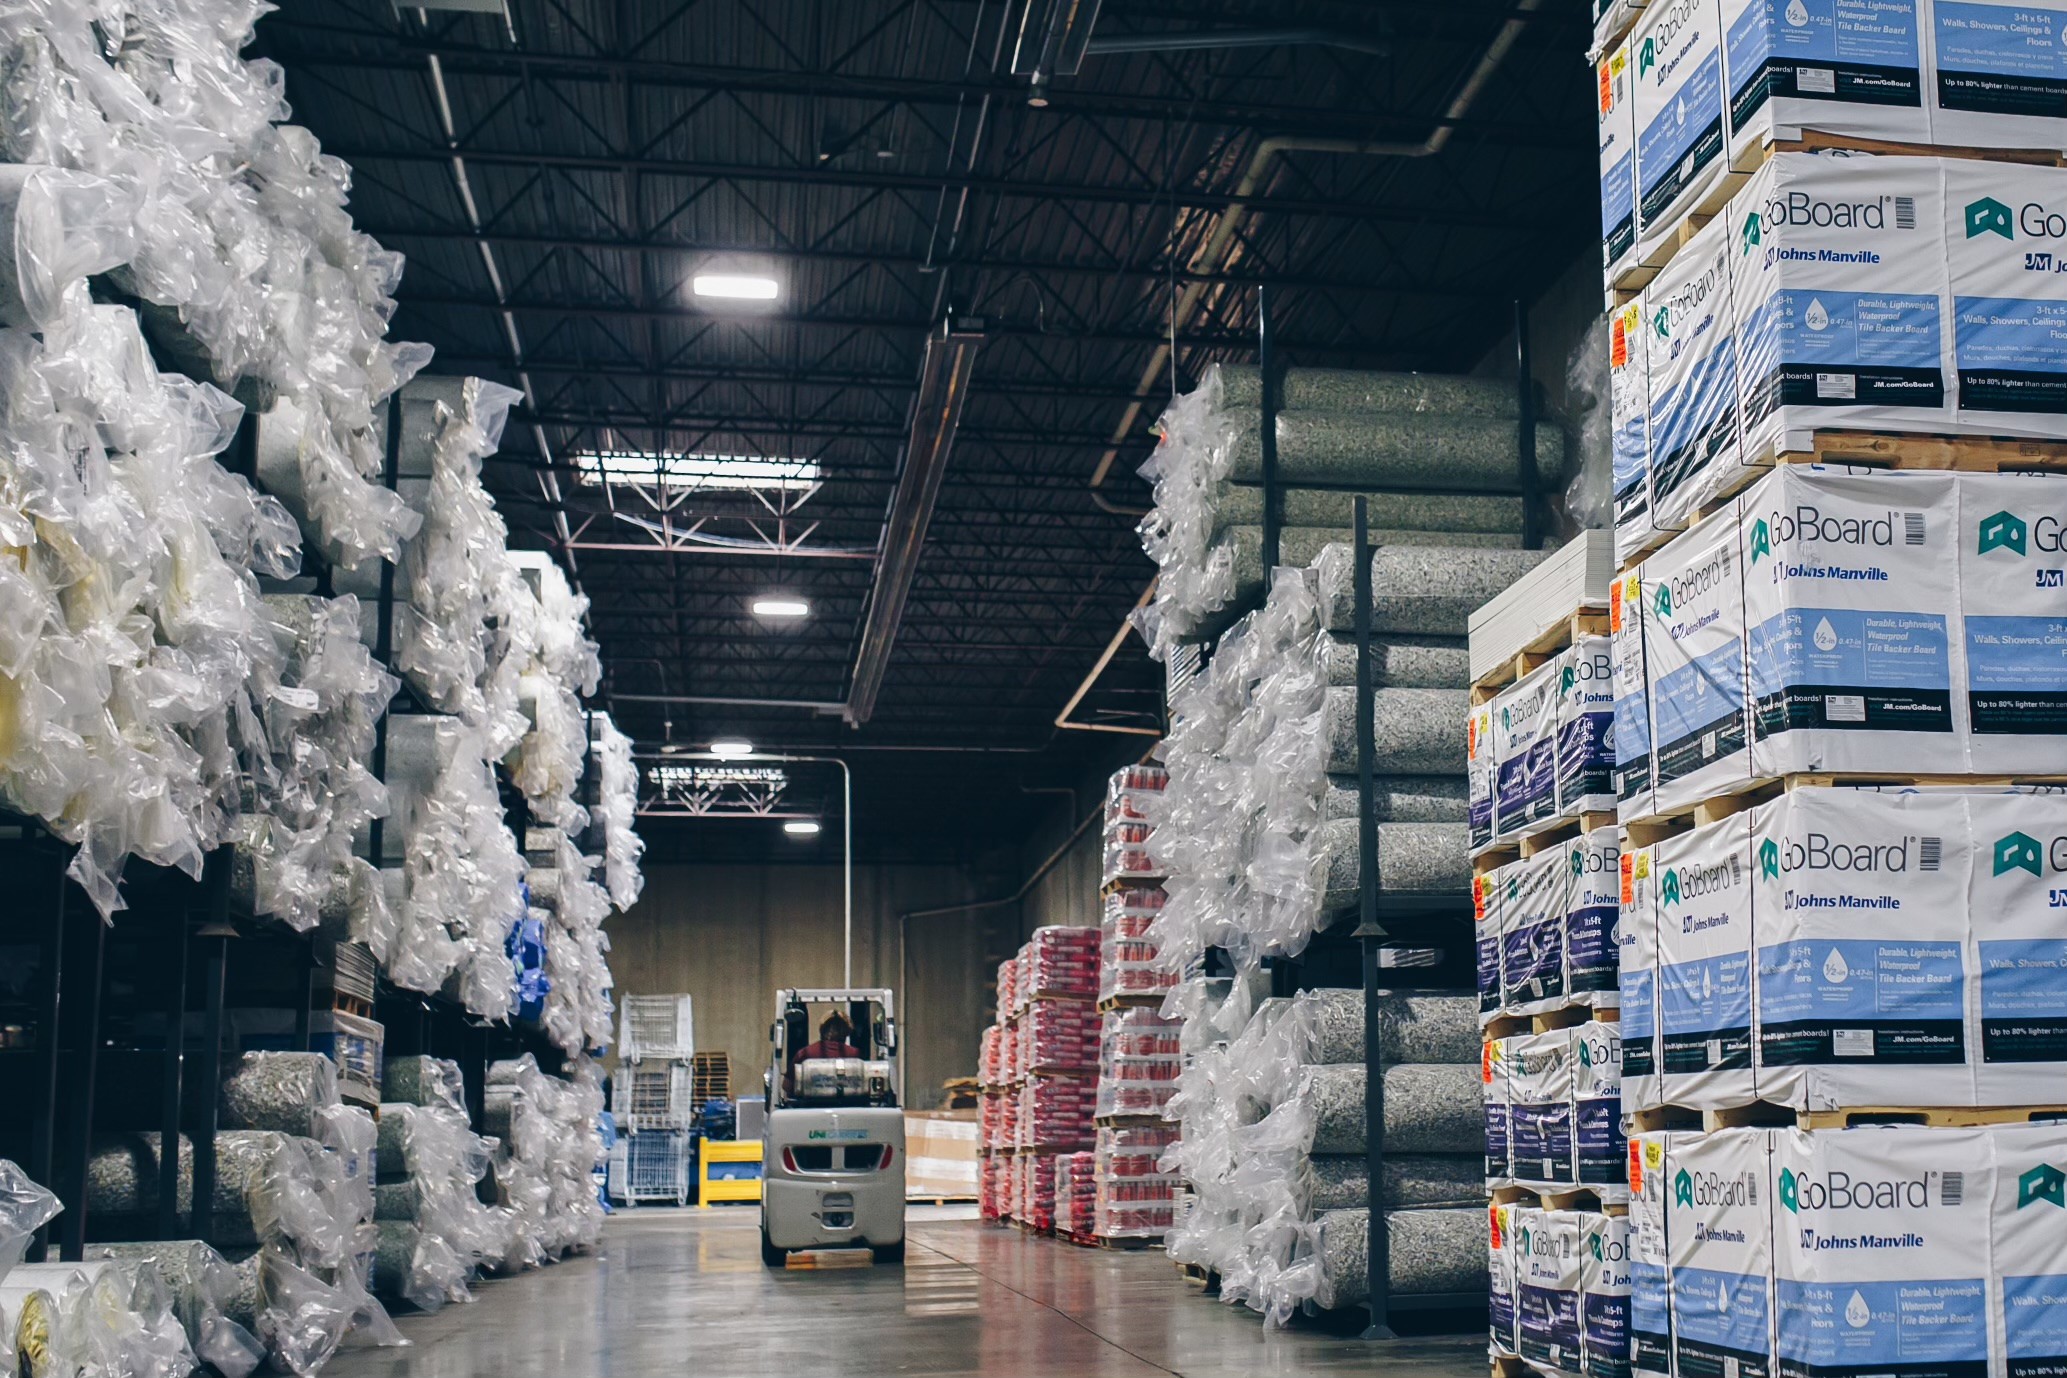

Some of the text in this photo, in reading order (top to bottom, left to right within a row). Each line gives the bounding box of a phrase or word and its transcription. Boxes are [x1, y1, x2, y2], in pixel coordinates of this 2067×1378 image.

[1837, 10, 1878, 22] Waterproof
[2014, 13, 2029, 23] 3-ft
[2036, 15, 2051, 25] 5-ft
[1837, 21, 1906, 36] Tile Backer Board
[1942, 18, 2052, 38] Walls, Showers, Ceilings &
[2026, 37, 2053, 47] Floors
[1945, 78, 1956, 87] Up
[1965, 80, 1980, 89] 80%
[1980, 82, 2003, 92] lighter
[2004, 83, 2019, 92] than
[2020, 85, 2044, 94] cement
[1775, 247, 1881, 265] Johns Manville
[1858, 298, 1936, 313] Durable, Lightweight,
[2036, 306, 2050, 315] 3-ft
[1858, 312, 1901, 323] Waterproof
[1962, 314, 2066, 328] Walls, Showers, Ceilings
[1859, 324, 1929, 335] Tile Backer Board
[1786, 372, 1814, 381] boards!
[1872, 381, 1935, 390] JM.com/GoBoard
[1967, 377, 1978, 386] Up
[1978, 378, 1986, 386] to
[1986, 378, 2001, 387] 80%
[2002, 379, 2024, 389] lighter
[2024, 380, 2041, 388] than
[1769, 505, 1892, 548] GoBoard
[1784, 563, 1889, 582] Johns Manville
[1866, 618, 1898, 628] Durable,
[2048, 624, 2062, 633] 3-ft
[1867, 630, 1909, 642] Waterproof
[1974, 634, 2043, 646] Walls, Showers,
[1866, 642, 1936, 655] Tile Backer Board
[1794, 694, 1822, 702] boards!
[1882, 704, 1942, 712] JM.com/GoBoard
[1977, 700, 1988, 708] Up
[1998, 700, 2014, 708] 80%
[2015, 700, 2038, 709] lighter
[1780, 832, 1907, 873] GoBoard
[1680, 856, 1730, 901] GoBoard
[1794, 893, 1901, 910] Johns Manville
[1878, 946, 1958, 960] Durable, Lightweight,
[1880, 960, 1921, 972] Waterproof
[1989, 958, 2059, 969] Walls, Showers,
[1879, 973, 1952, 984] Tile Backer Board
[1990, 1026, 2052, 1037] Up to 80% lighter
[1892, 1034, 1954, 1043] JM.com/GoBoard
[1794, 1171, 1929, 1211] GoBoard
[1815, 1234, 1857, 1251] Johns
[1859, 1233, 1924, 1250] Manville
[1901, 1300, 1945, 1312] Waterproof
[1901, 1314, 1917, 1326] Tile
[2015, 1366, 2053, 1377] Up to 80%
